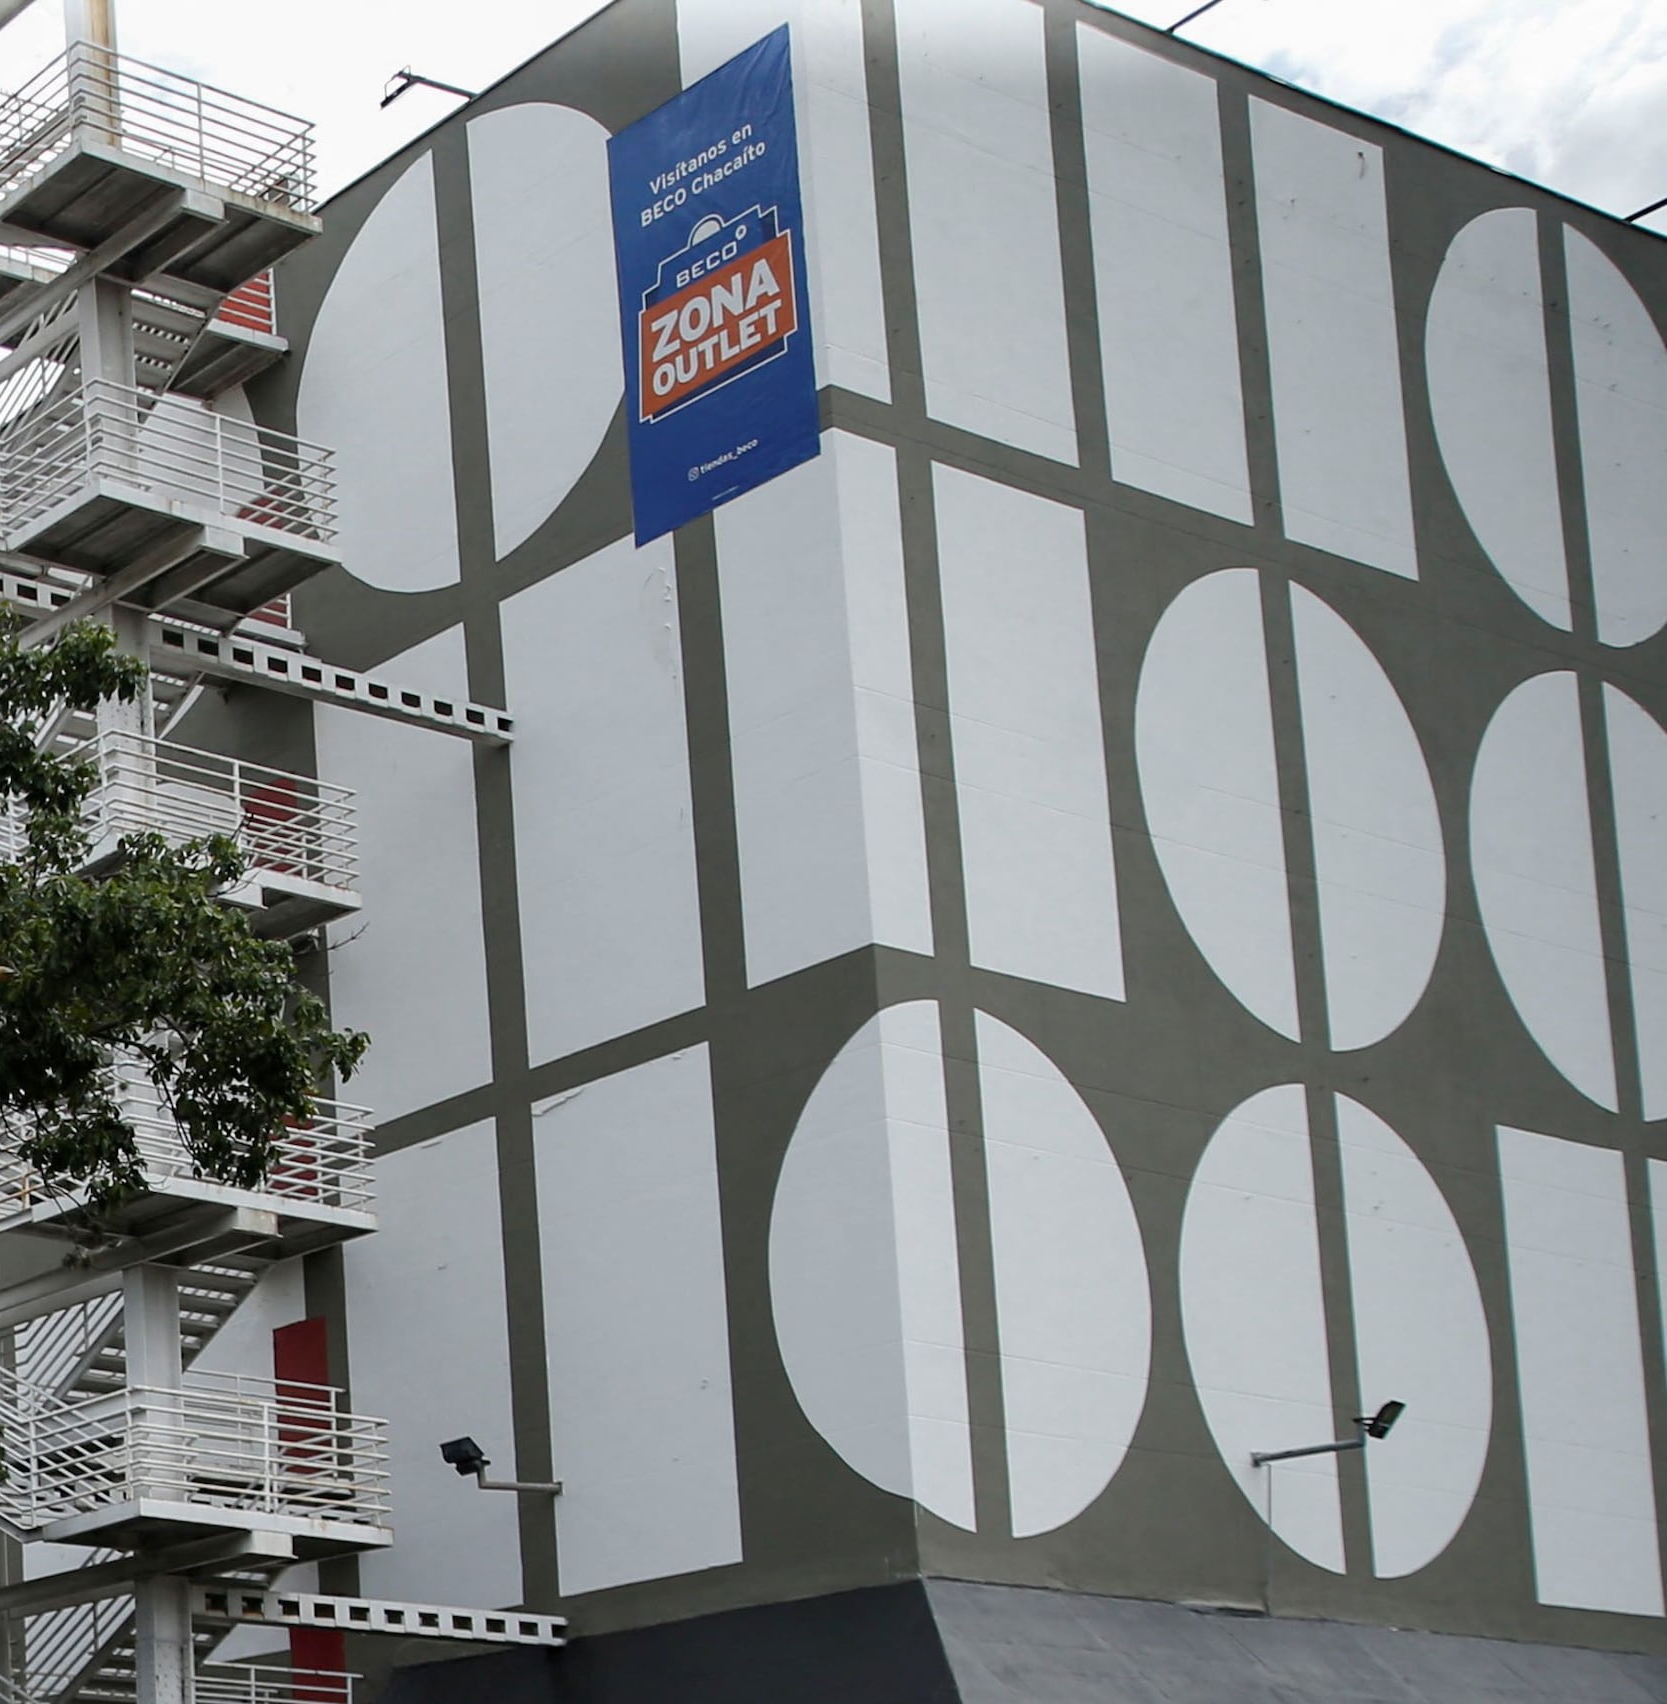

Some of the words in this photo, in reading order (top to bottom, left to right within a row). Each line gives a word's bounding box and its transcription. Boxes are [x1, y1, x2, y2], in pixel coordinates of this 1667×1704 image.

[640, 187, 687, 227] BECO
[691, 142, 766, 194] Chacaíto
[649, 139, 727, 195] Visítanos
[731, 124, 752, 145] en
[676, 240, 738, 288] BECO
[651, 258, 780, 363] ZONA
[652, 299, 782, 396] OUTLET
